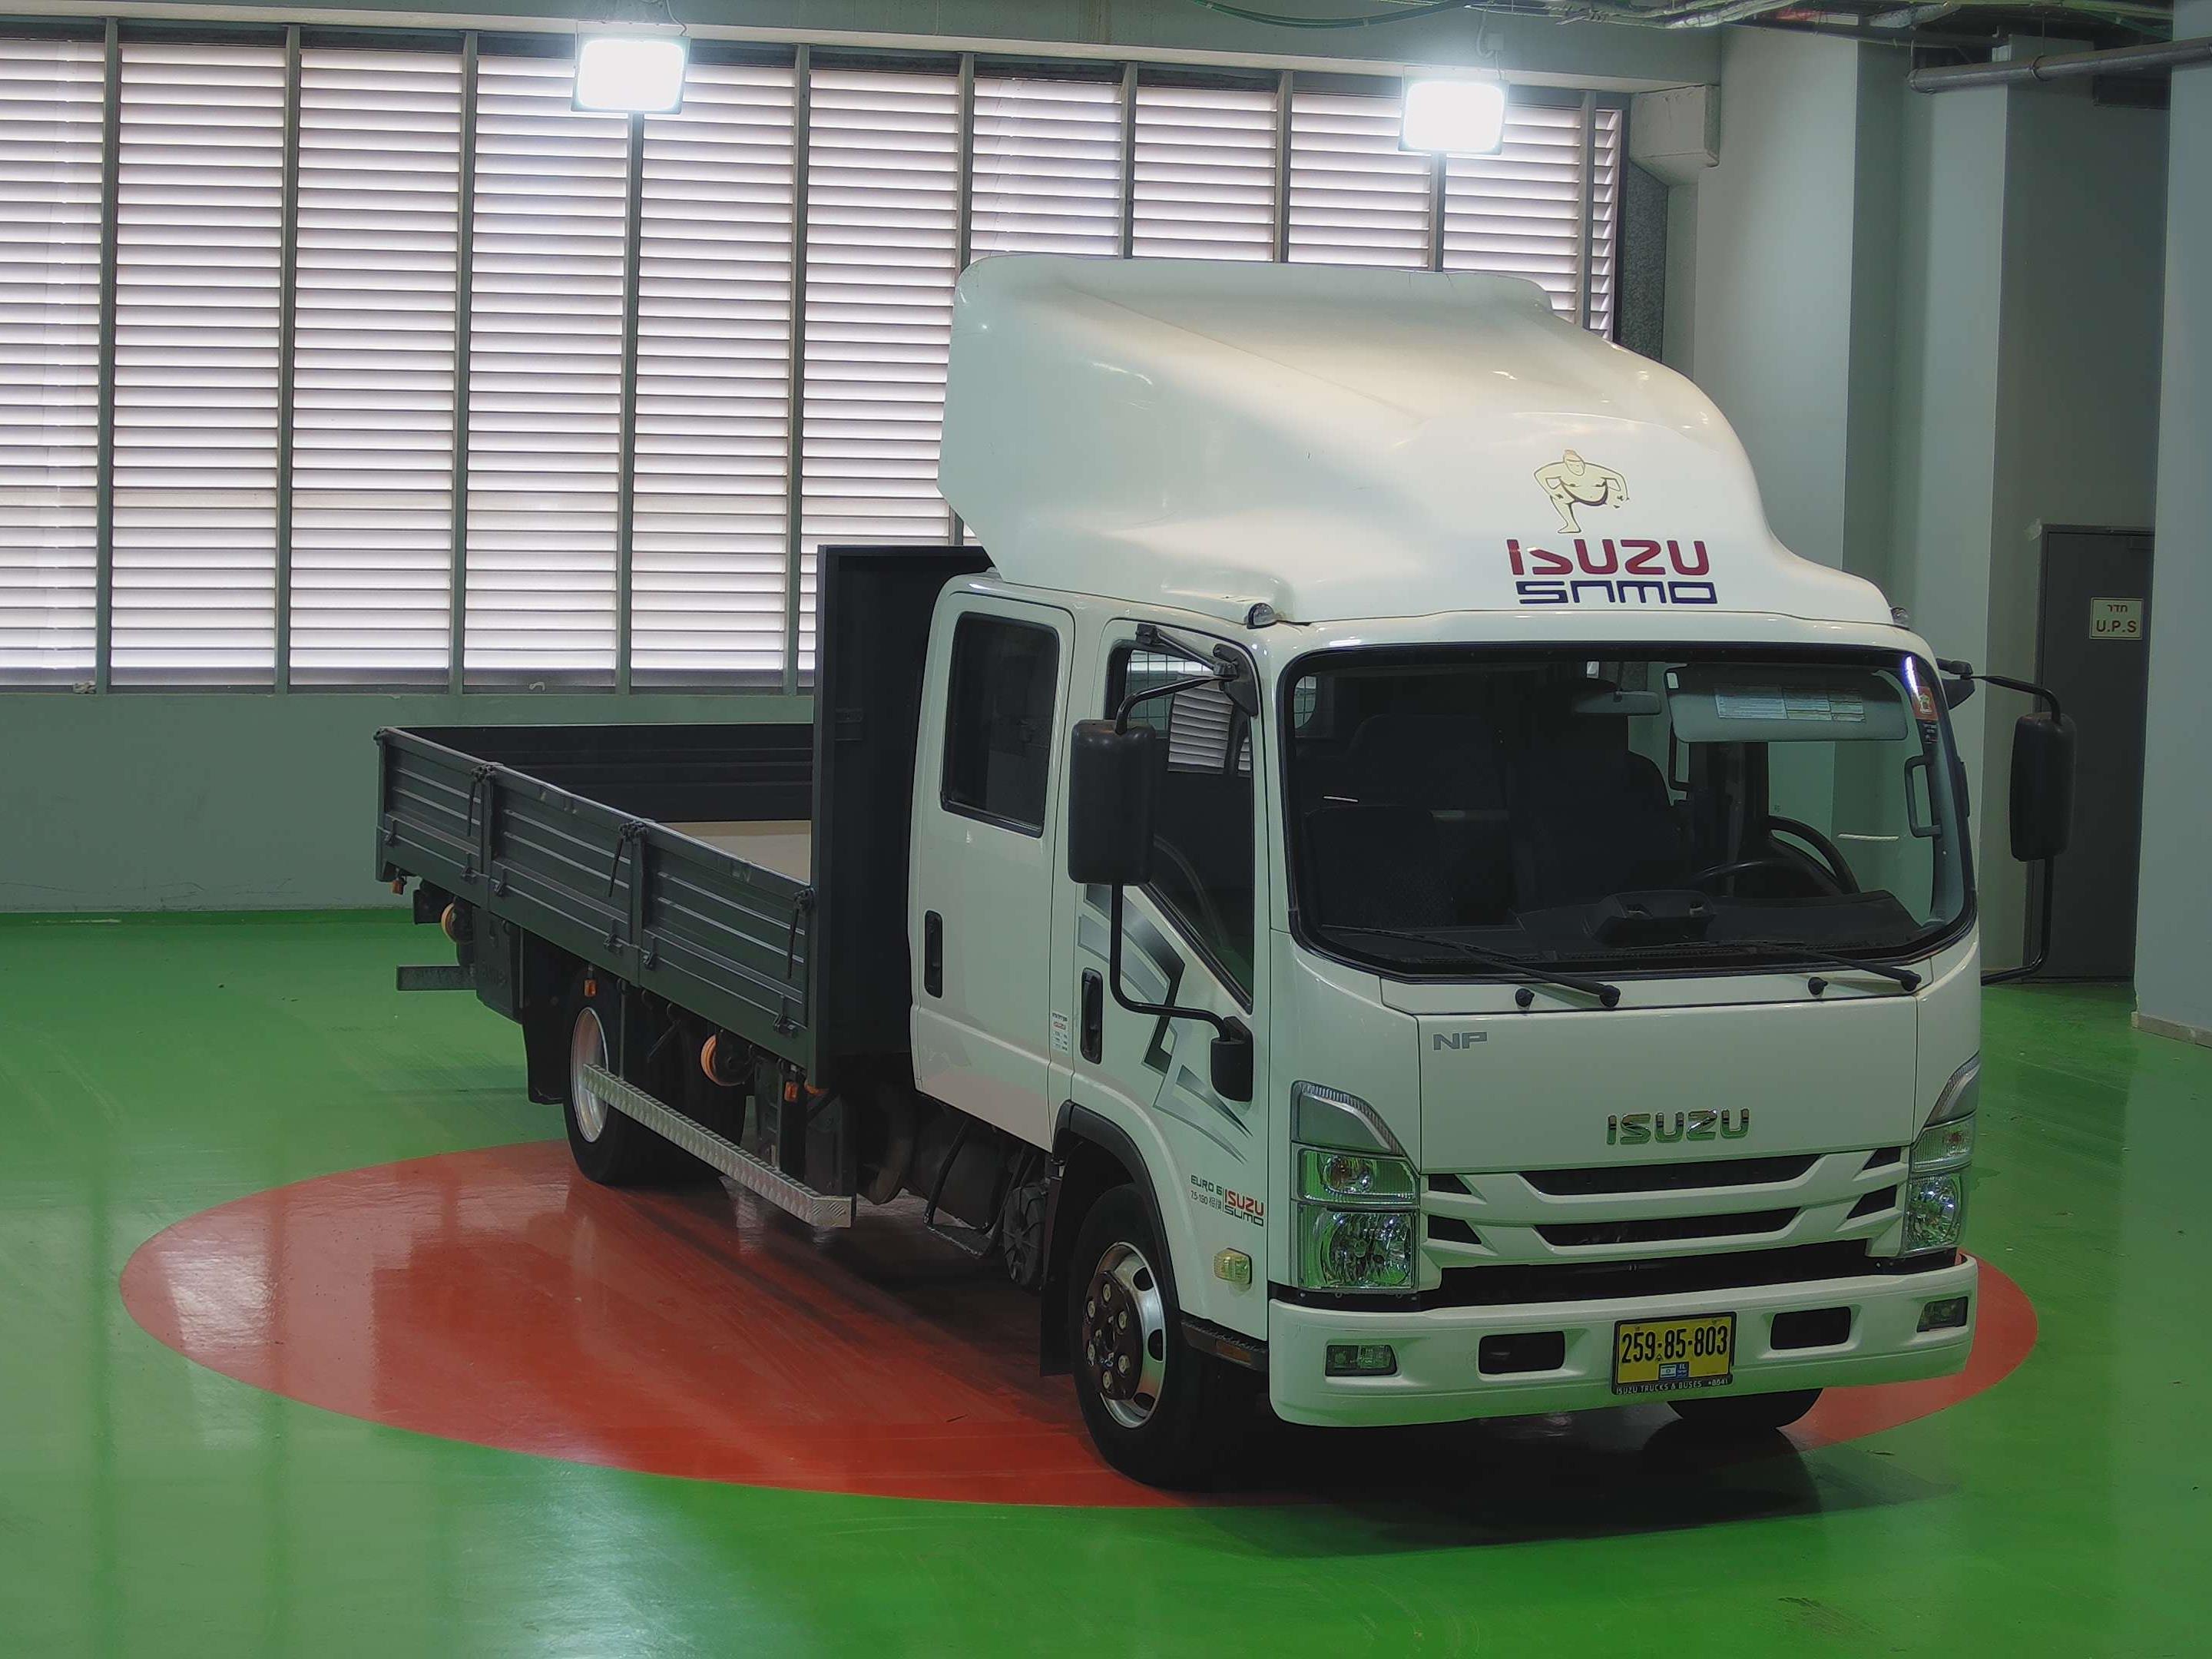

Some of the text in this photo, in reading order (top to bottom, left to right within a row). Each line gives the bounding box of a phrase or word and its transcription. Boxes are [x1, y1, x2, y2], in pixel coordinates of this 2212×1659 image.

[1506, 538, 1710, 575] ISUZU
[2107, 604, 2128, 612] חדר
[2096, 620, 2137, 633] U.P.S
[1432, 1031, 1488, 1051] NP
[1606, 1108, 1750, 1145] ISUZU
[1190, 1174, 1223, 1196] EURO 6
[1224, 1189, 1264, 1217] ISUZU
[1224, 1204, 1264, 1227] SUMO
[1641, 1383, 1669, 1392] TRUCKS
[1678, 1380, 1703, 1389] BUSES
